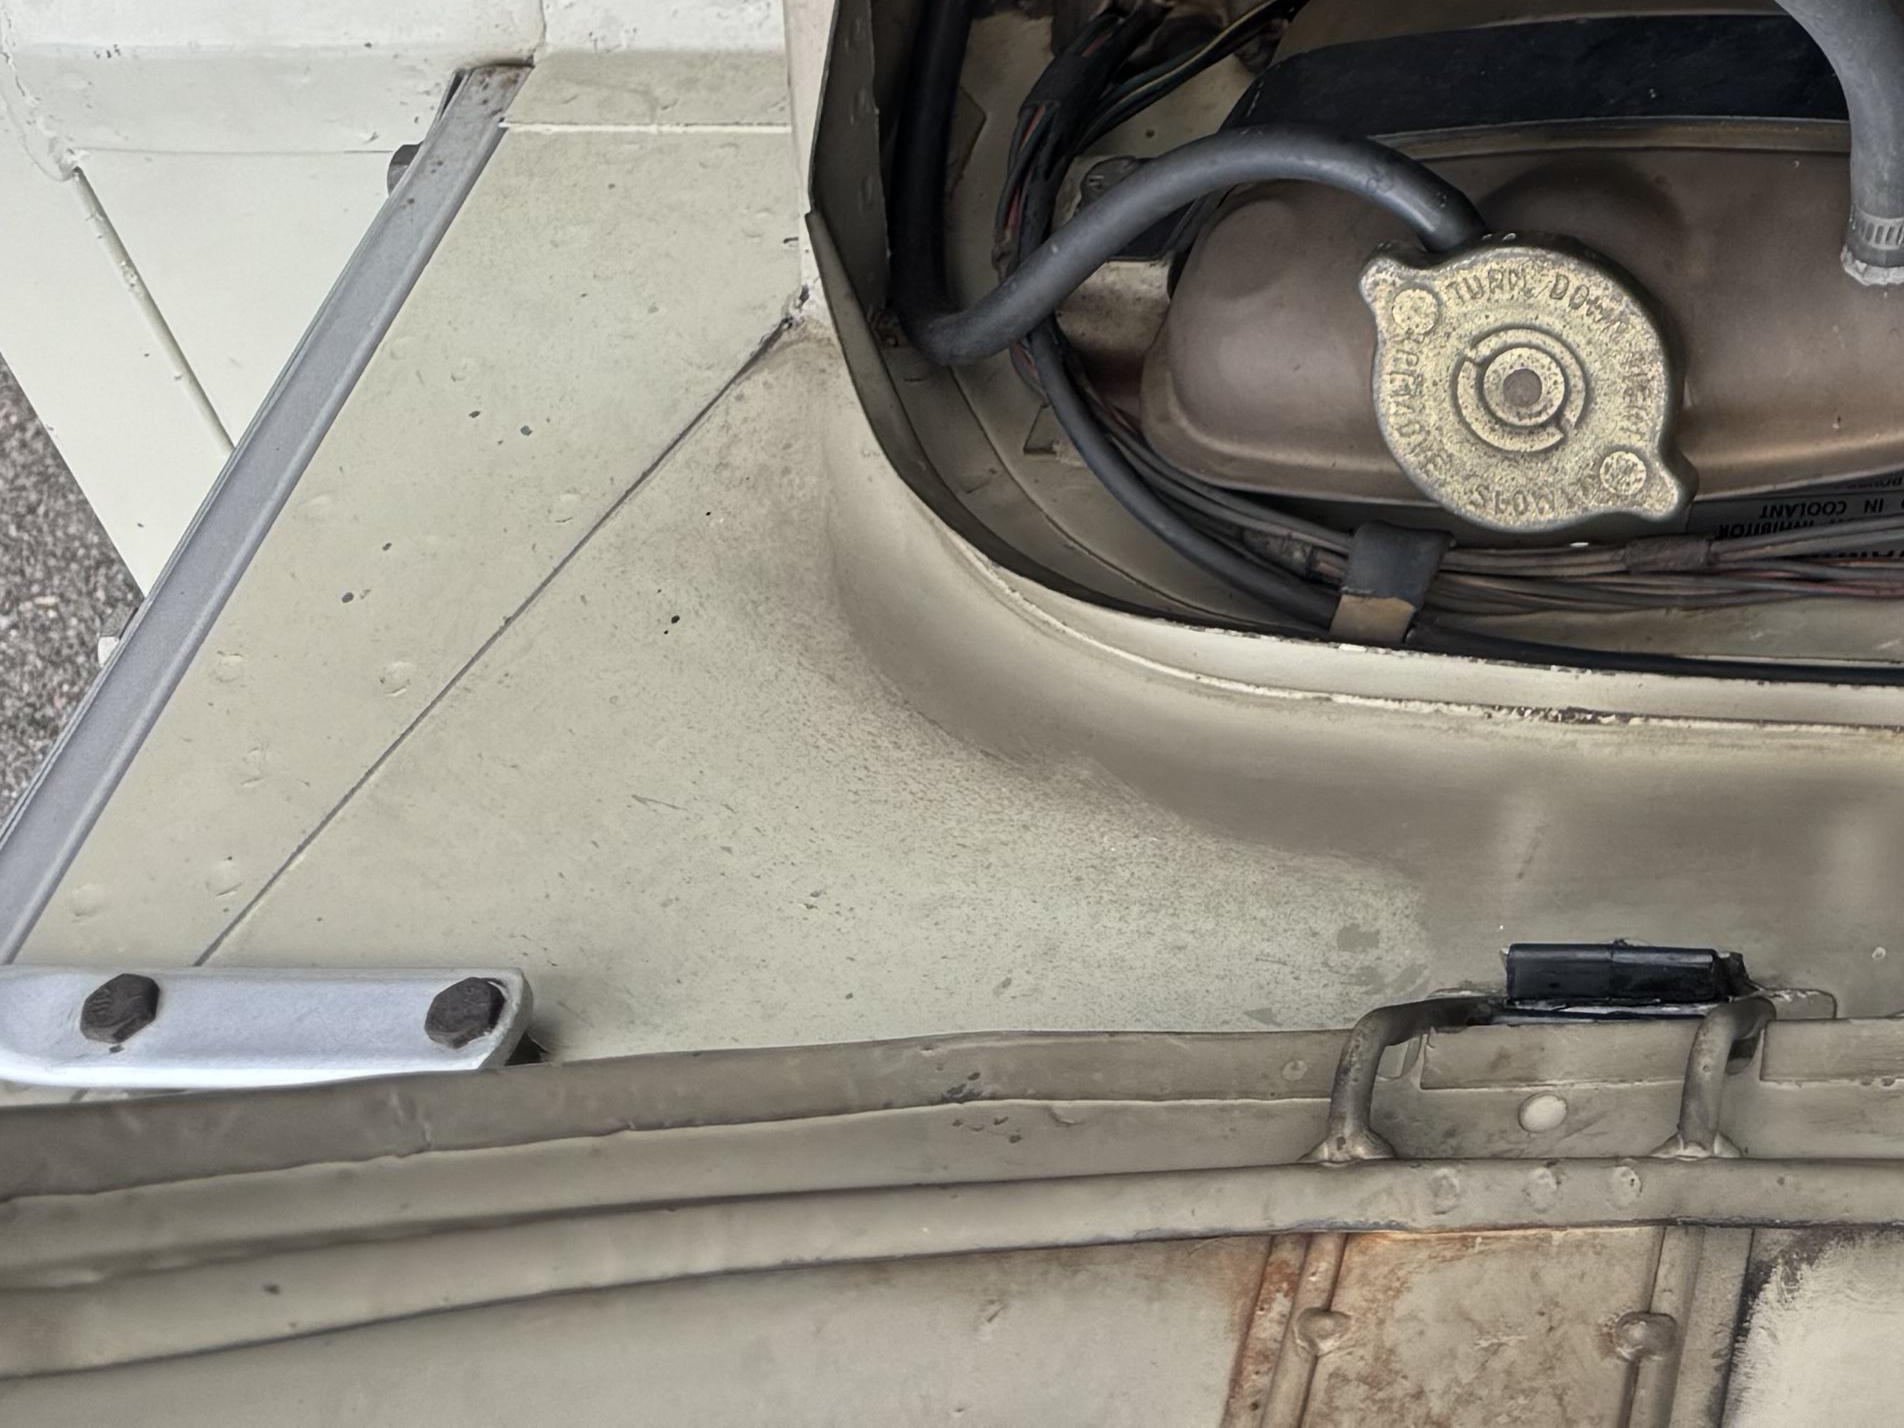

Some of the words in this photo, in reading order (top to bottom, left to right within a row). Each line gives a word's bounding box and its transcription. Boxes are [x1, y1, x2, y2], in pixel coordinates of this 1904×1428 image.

[1446, 267, 1530, 304] TURN
[1757, 499, 1848, 520] COOLANT
[1863, 497, 1885, 514] IN
